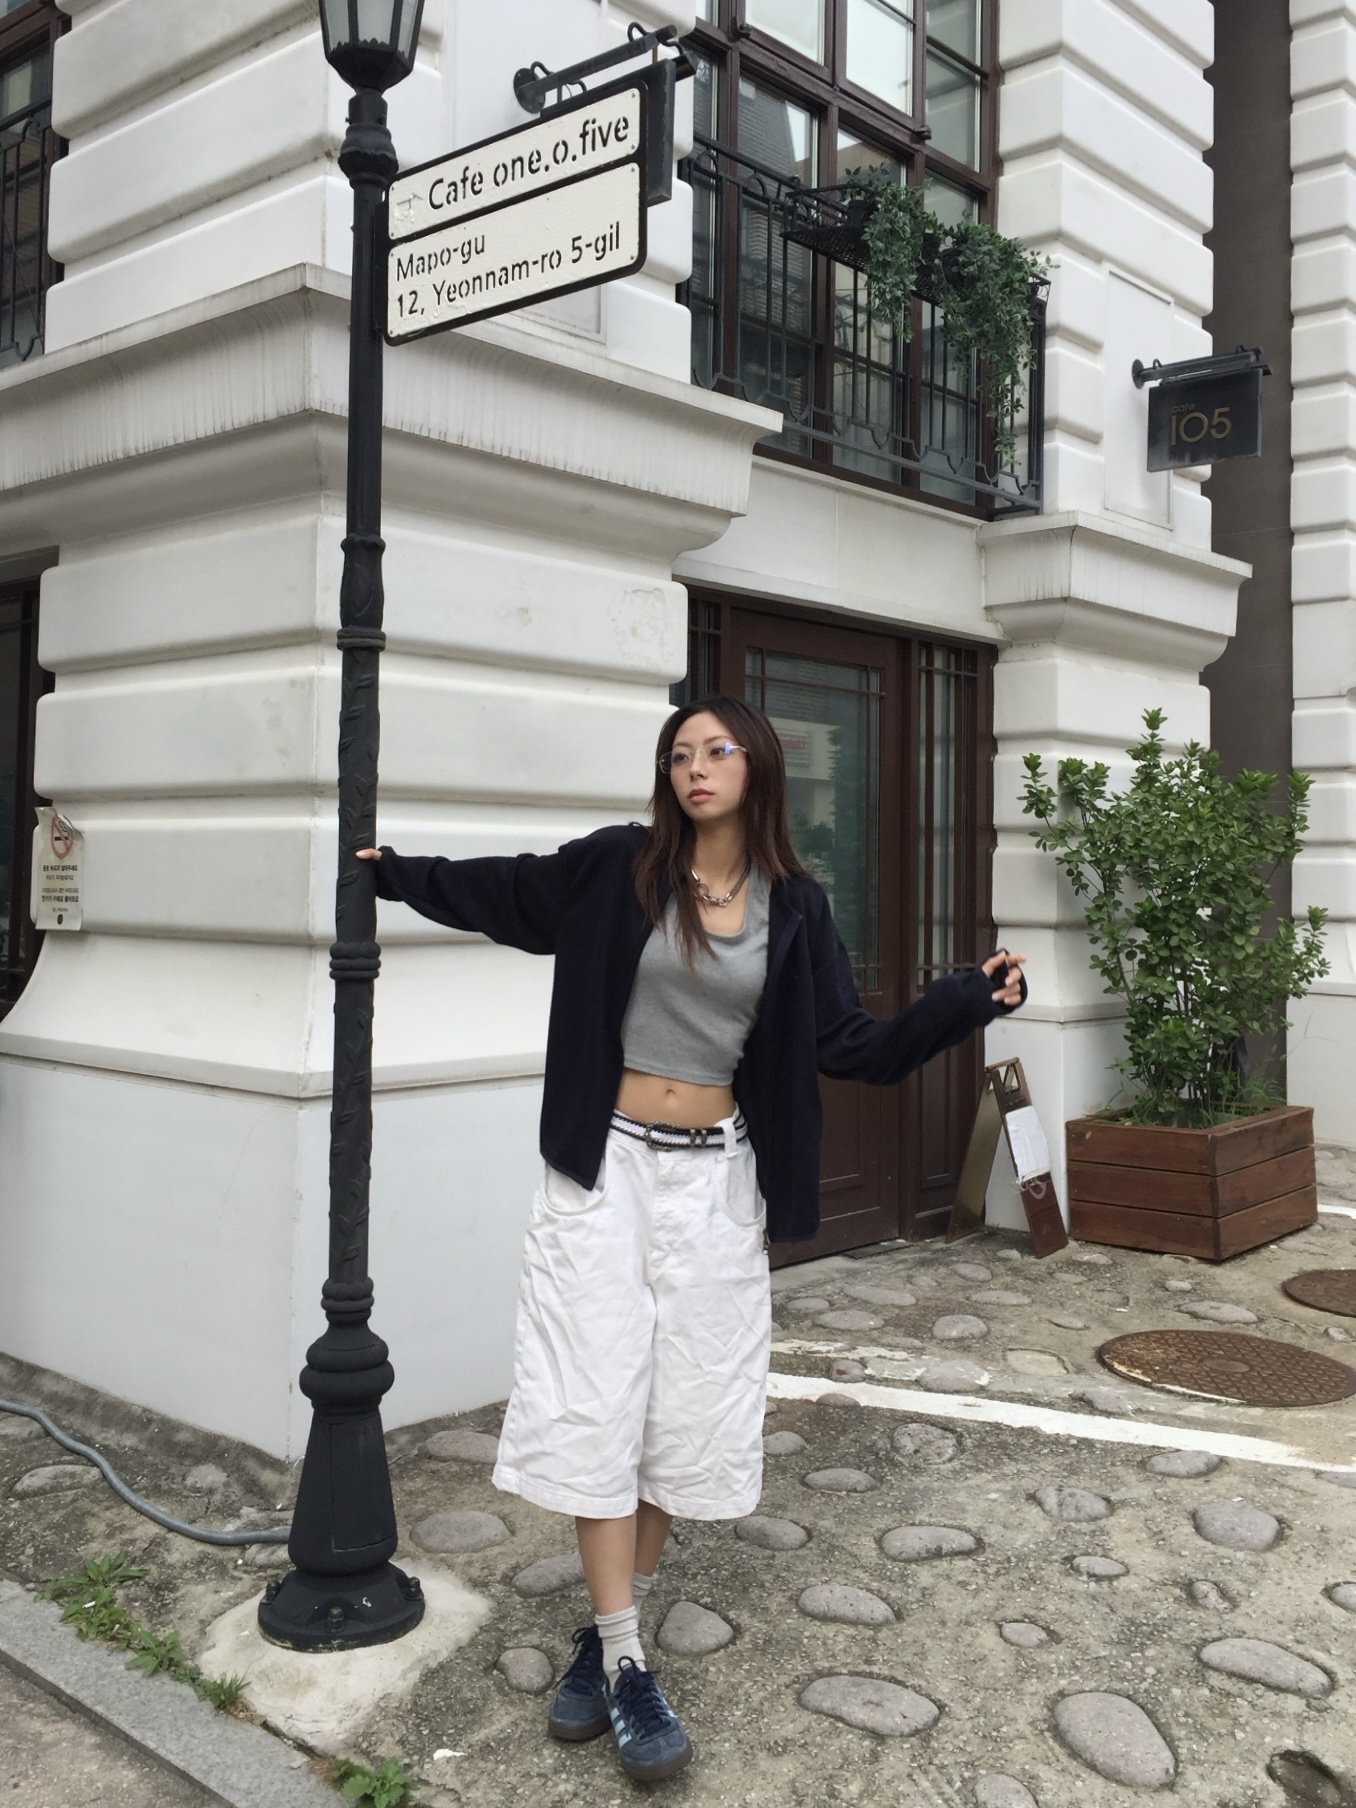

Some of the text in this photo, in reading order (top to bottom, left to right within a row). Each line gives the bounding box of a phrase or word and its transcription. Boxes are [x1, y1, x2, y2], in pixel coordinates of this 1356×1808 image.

[428, 115, 630, 210] Cafe one.o.five
[396, 234, 486, 282] Mapo-gu
[397, 221, 621, 318] 12, Yeonnam-ro 5-gil
[1170, 407, 1232, 445] 105
